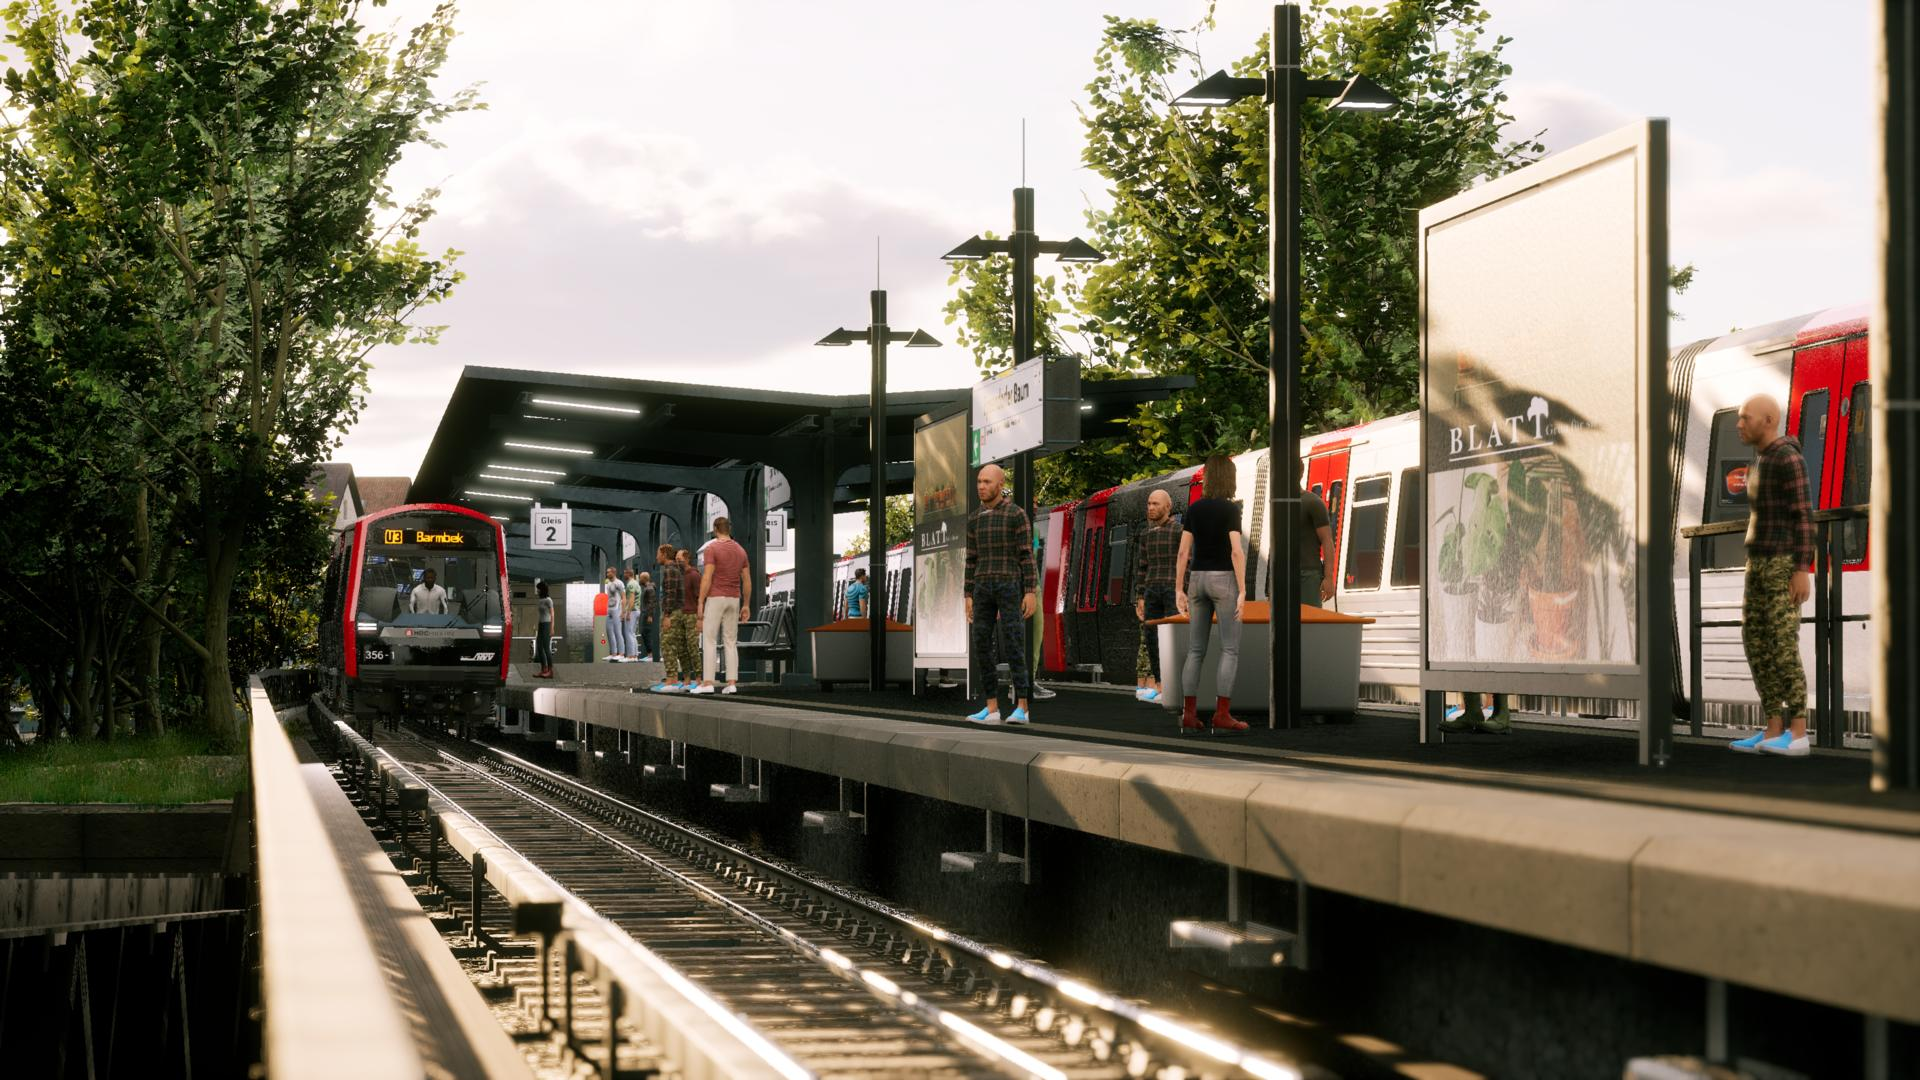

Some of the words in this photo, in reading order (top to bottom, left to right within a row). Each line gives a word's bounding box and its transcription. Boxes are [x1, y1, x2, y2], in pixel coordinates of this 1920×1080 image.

[1013, 382, 1030, 404] Baum
[1449, 396, 1549, 455] BLATT
[541, 516, 562, 524] Gleis
[386, 529, 402, 543] U3
[416, 531, 464, 543] Barmbek
[545, 526, 556, 542] 2
[921, 521, 947, 548] BLATT
[365, 650, 395, 660] 356-1
